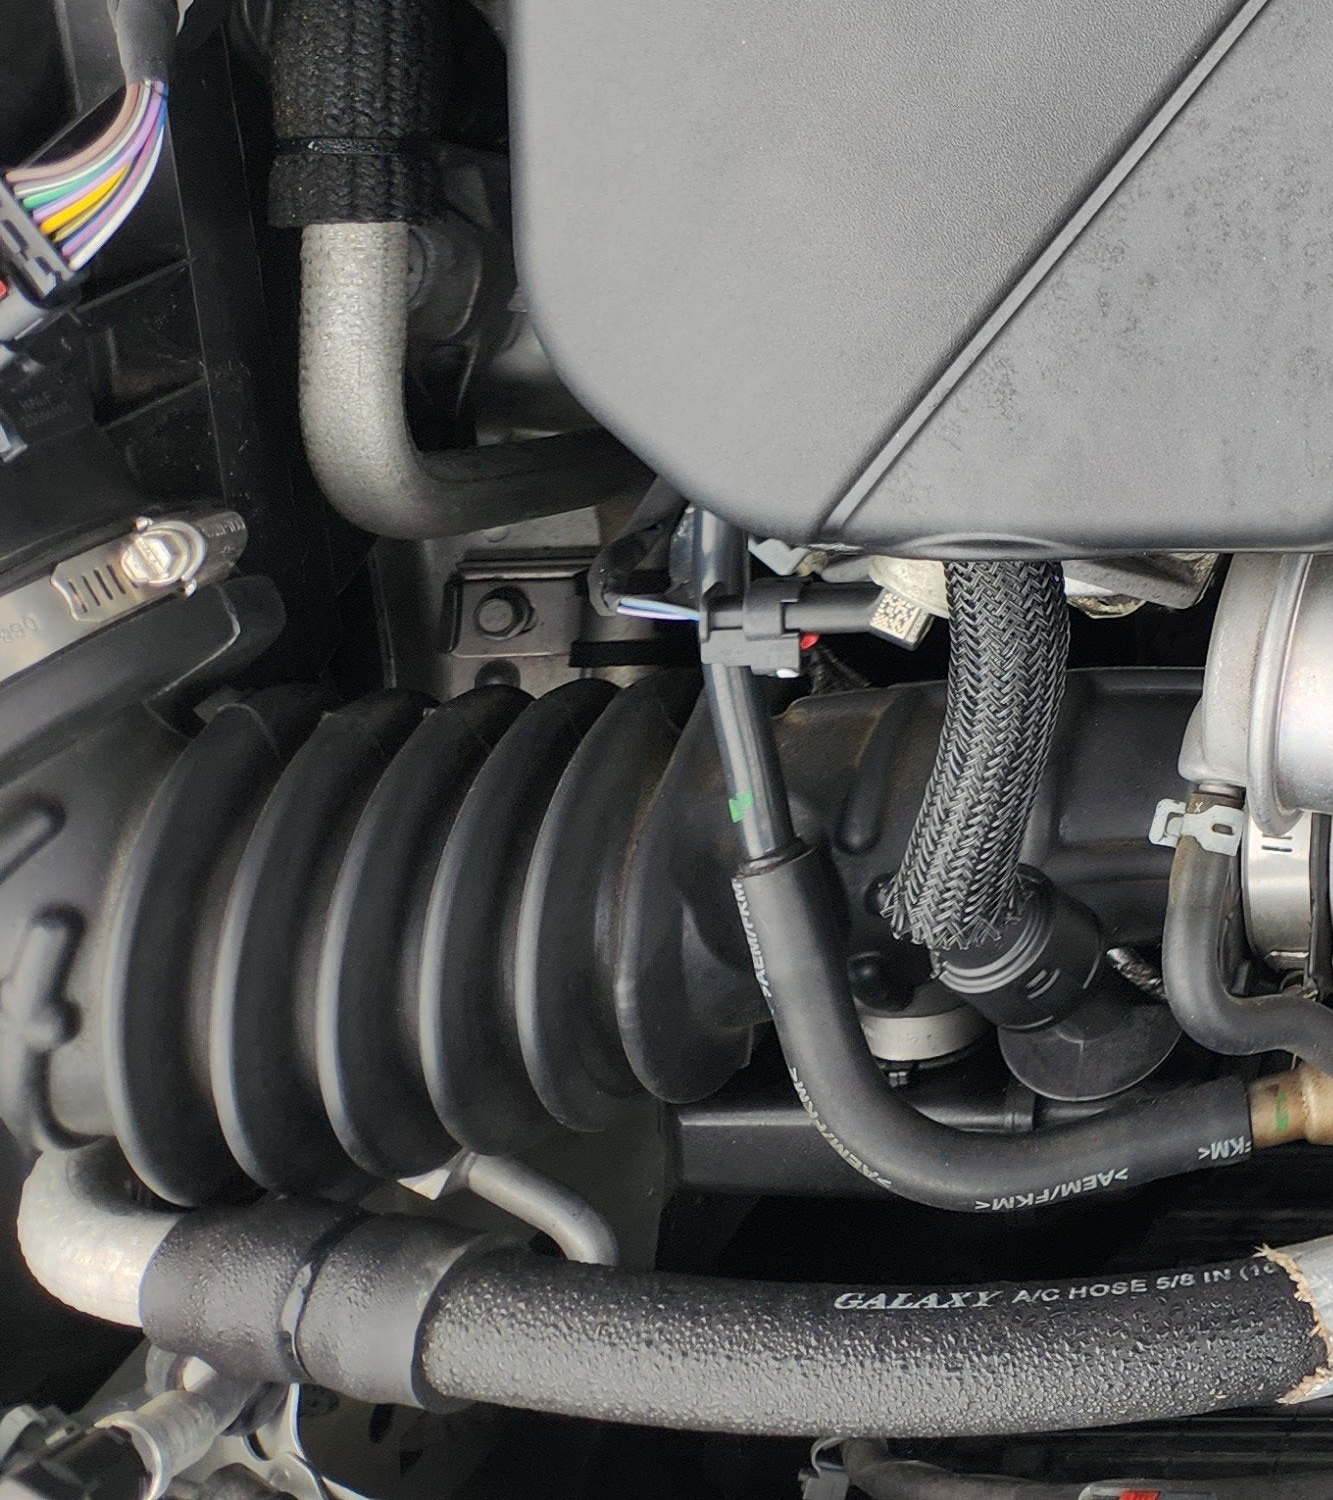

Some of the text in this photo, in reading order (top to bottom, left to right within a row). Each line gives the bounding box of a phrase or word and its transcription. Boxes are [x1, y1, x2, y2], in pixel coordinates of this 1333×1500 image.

[975, 1167, 1129, 1211] >AEM/FKM<
[833, 1291, 1003, 1310] GALAXY
[1011, 1287, 1059, 1304] A/C
[1069, 1277, 1148, 1300] HOSE
[1156, 1273, 1196, 1290] 5/8
[1203, 1267, 1231, 1284] IN
